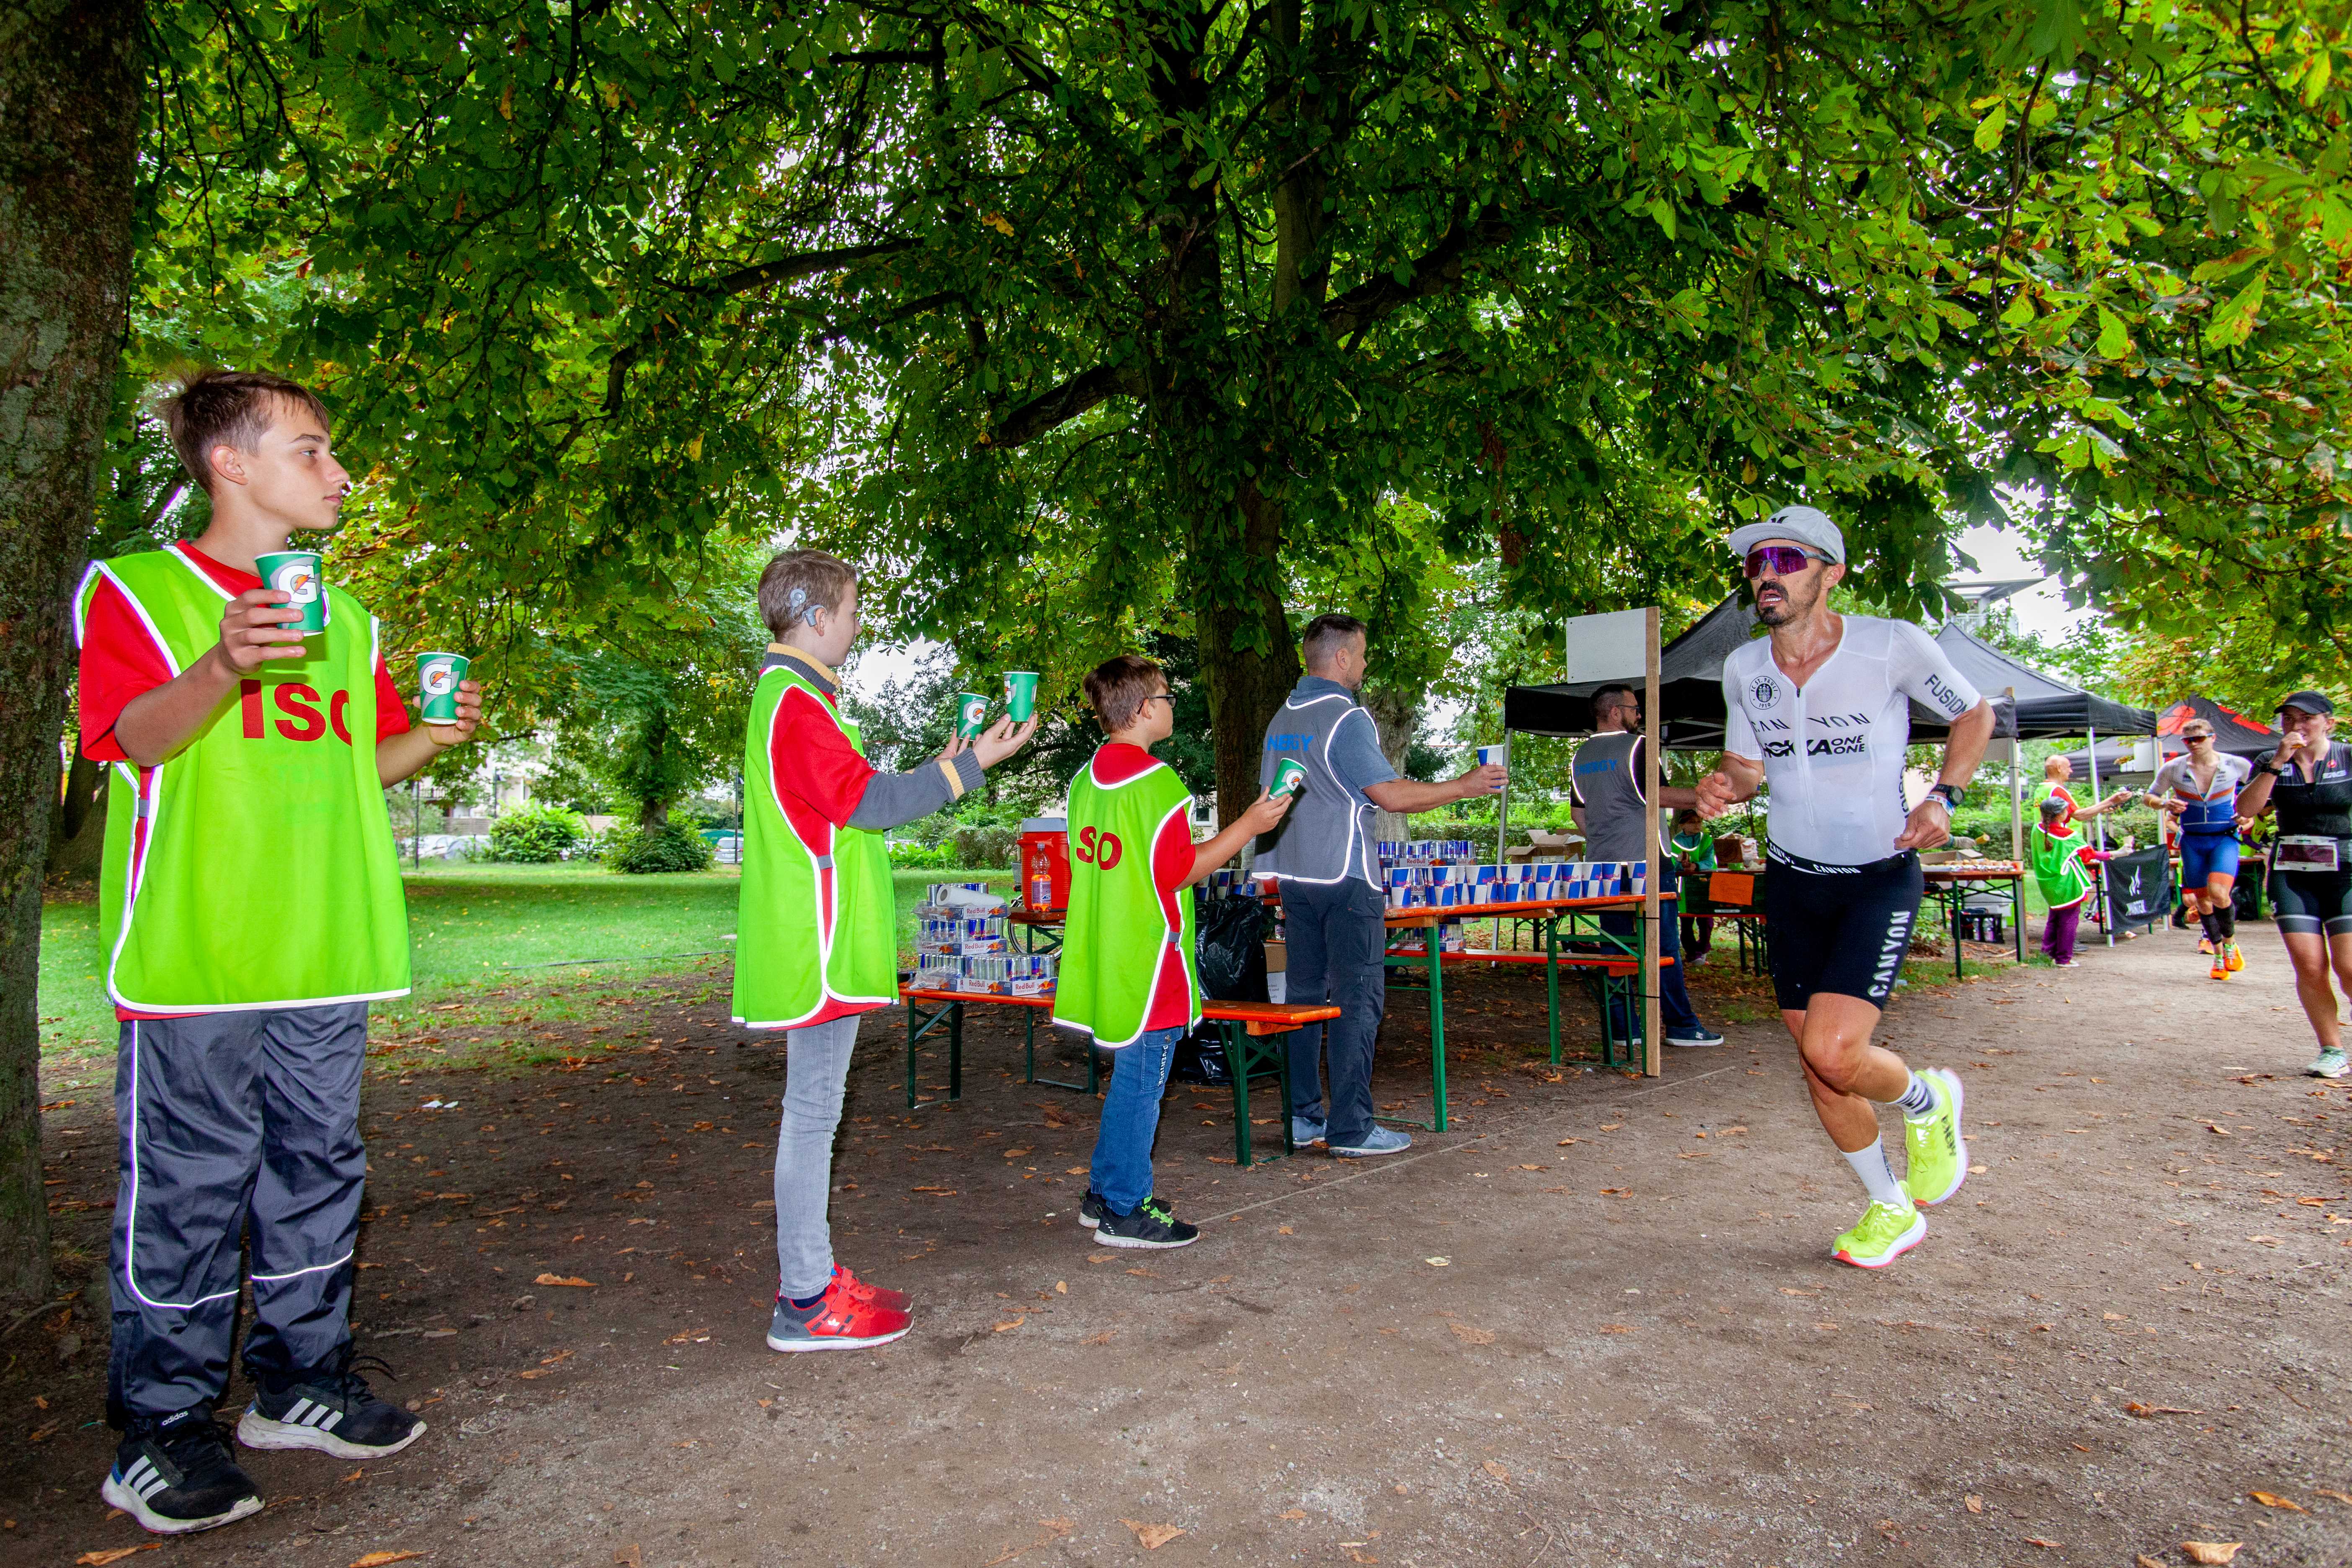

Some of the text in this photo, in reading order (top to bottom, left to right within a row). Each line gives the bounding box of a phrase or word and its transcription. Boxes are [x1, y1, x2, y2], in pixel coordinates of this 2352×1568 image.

[422, 663, 452, 695] G
[1764, 678, 1779, 692] PAULI
[1924, 673, 1968, 715] FUSION
[1831, 735, 1864, 746] ONE
[1834, 743, 1865, 755] ONE
[1813, 864, 1861, 874] CANYON
[1867, 910, 1911, 998] CANYON
[162, 1411, 188, 1426] adidas
